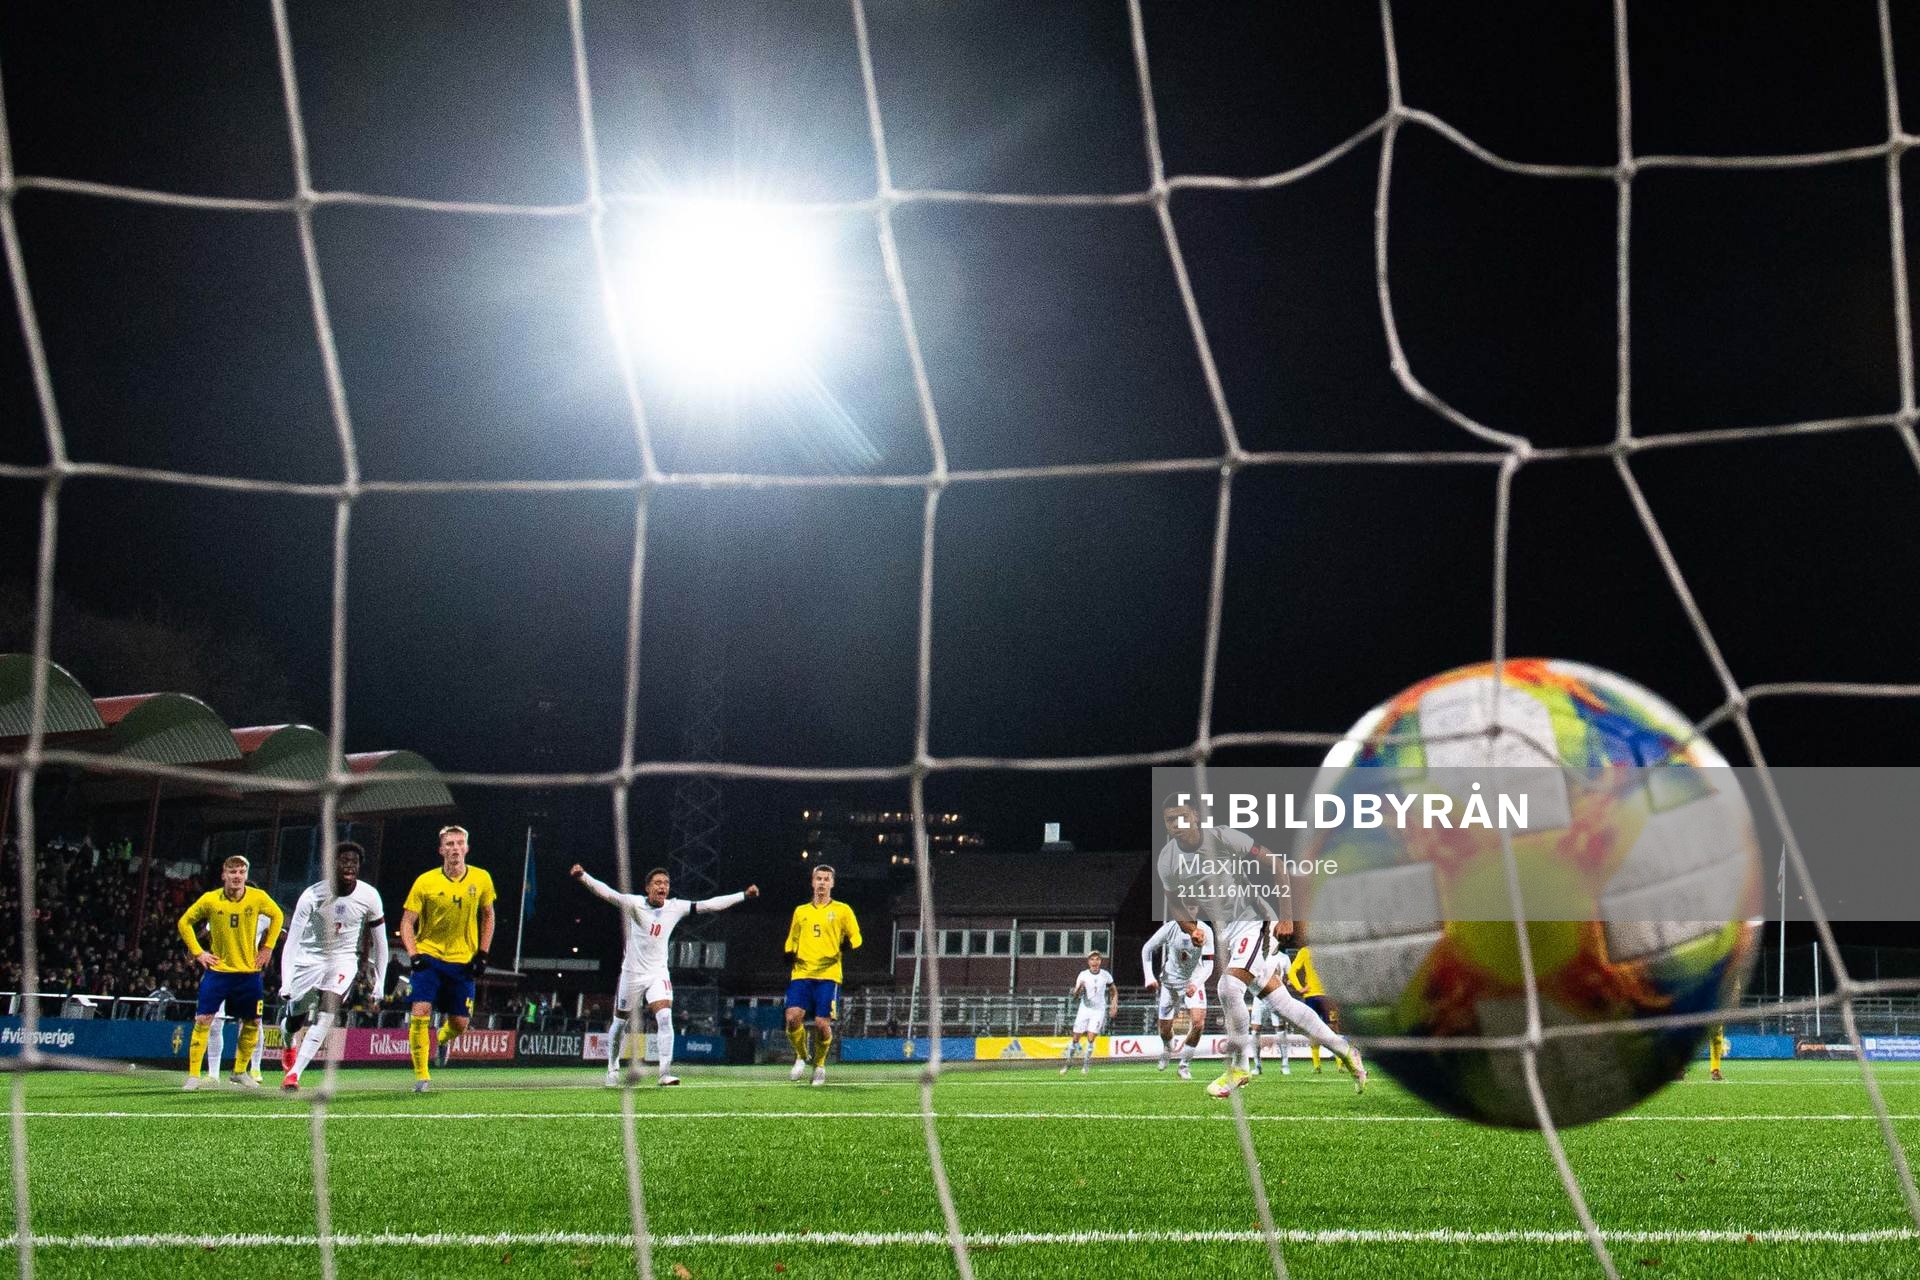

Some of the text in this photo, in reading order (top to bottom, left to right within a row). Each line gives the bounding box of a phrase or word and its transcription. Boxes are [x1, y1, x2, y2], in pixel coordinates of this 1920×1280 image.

[452, 895, 462, 909] 4
[230, 913, 239, 928] 8
[650, 923, 661, 936] 10
[813, 924, 821, 938] 5
[1238, 938, 1249, 954] 9
[1, 1027, 75, 1048] #viäsverige
[448, 1033, 510, 1053] AUHAUS
[518, 1034, 581, 1056] CAVALIERE
[1115, 1039, 1143, 1054] ICA
